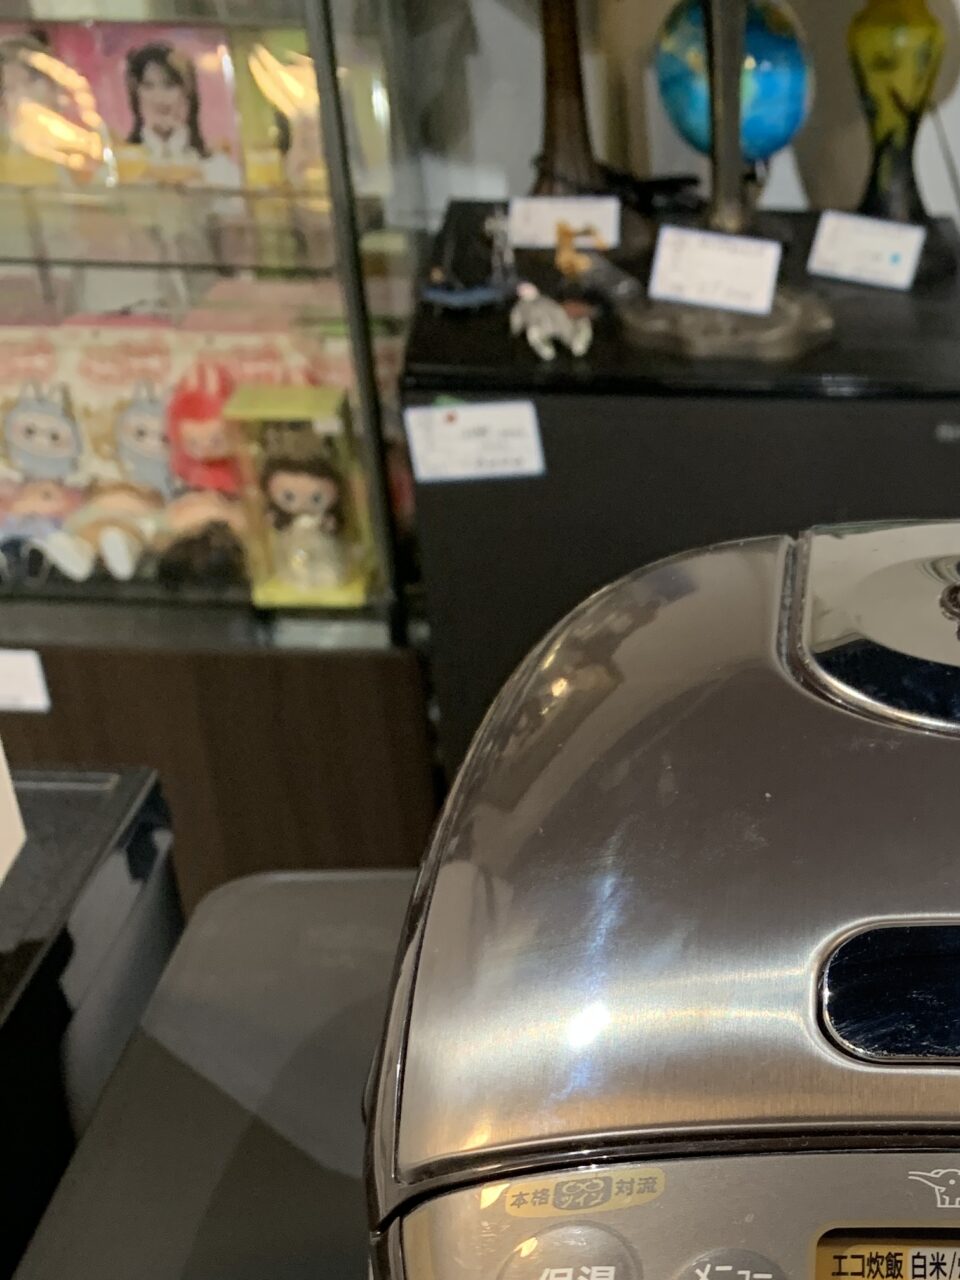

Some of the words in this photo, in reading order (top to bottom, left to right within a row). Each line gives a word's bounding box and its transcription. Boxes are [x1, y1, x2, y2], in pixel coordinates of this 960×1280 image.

[510, 1190, 552, 1208] 本格
[615, 1178, 657, 1196] 対流
[832, 1252, 903, 1280] エコ炊飯
